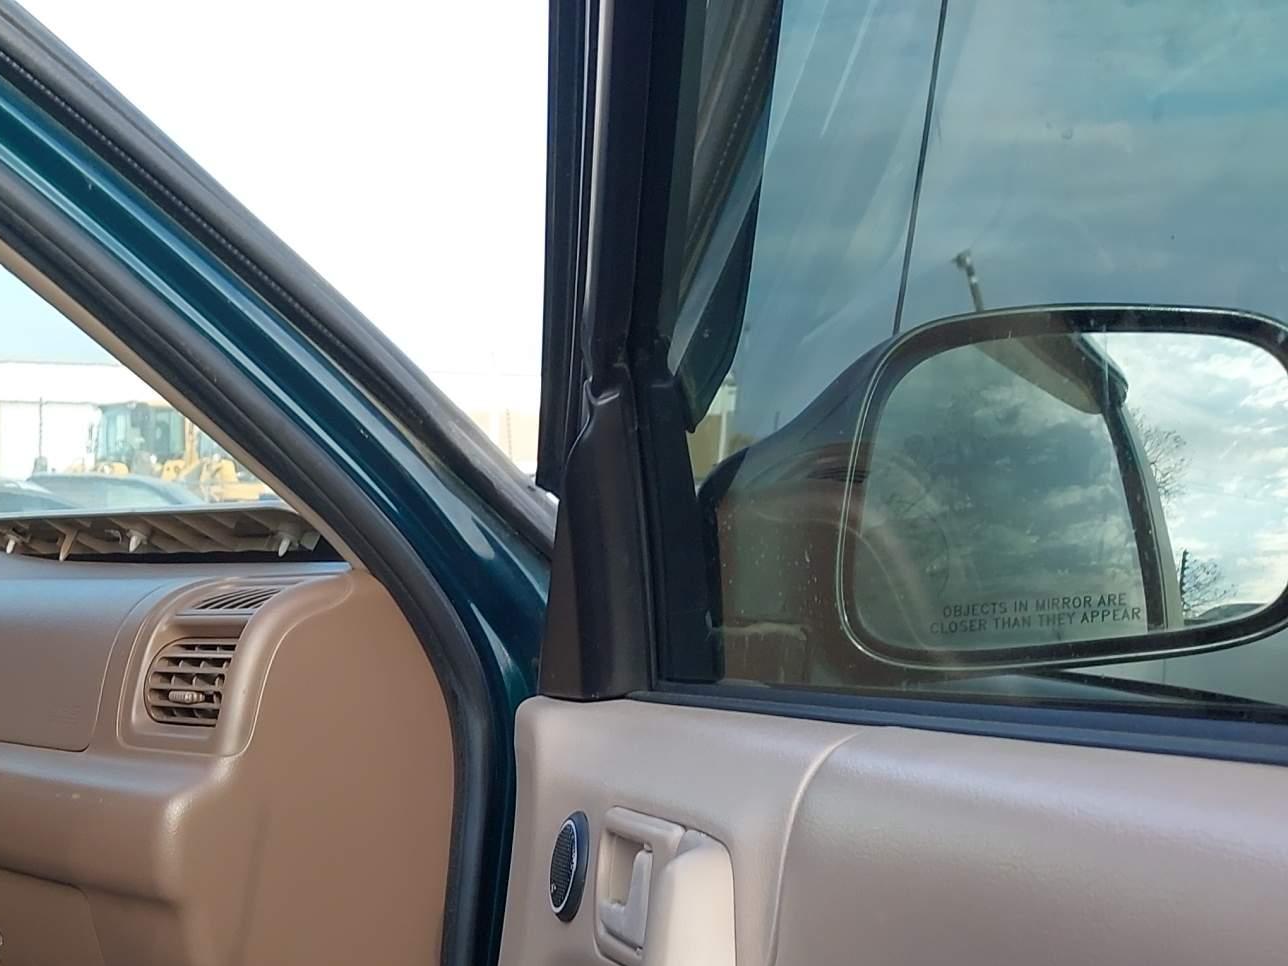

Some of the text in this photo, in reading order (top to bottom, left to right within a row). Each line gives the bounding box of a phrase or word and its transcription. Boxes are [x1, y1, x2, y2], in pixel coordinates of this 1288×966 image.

[943, 592, 1127, 618] OBJECTS IN MIRROR ARE
[930, 607, 1141, 634] CLOSER THAN THEY APPEAR
